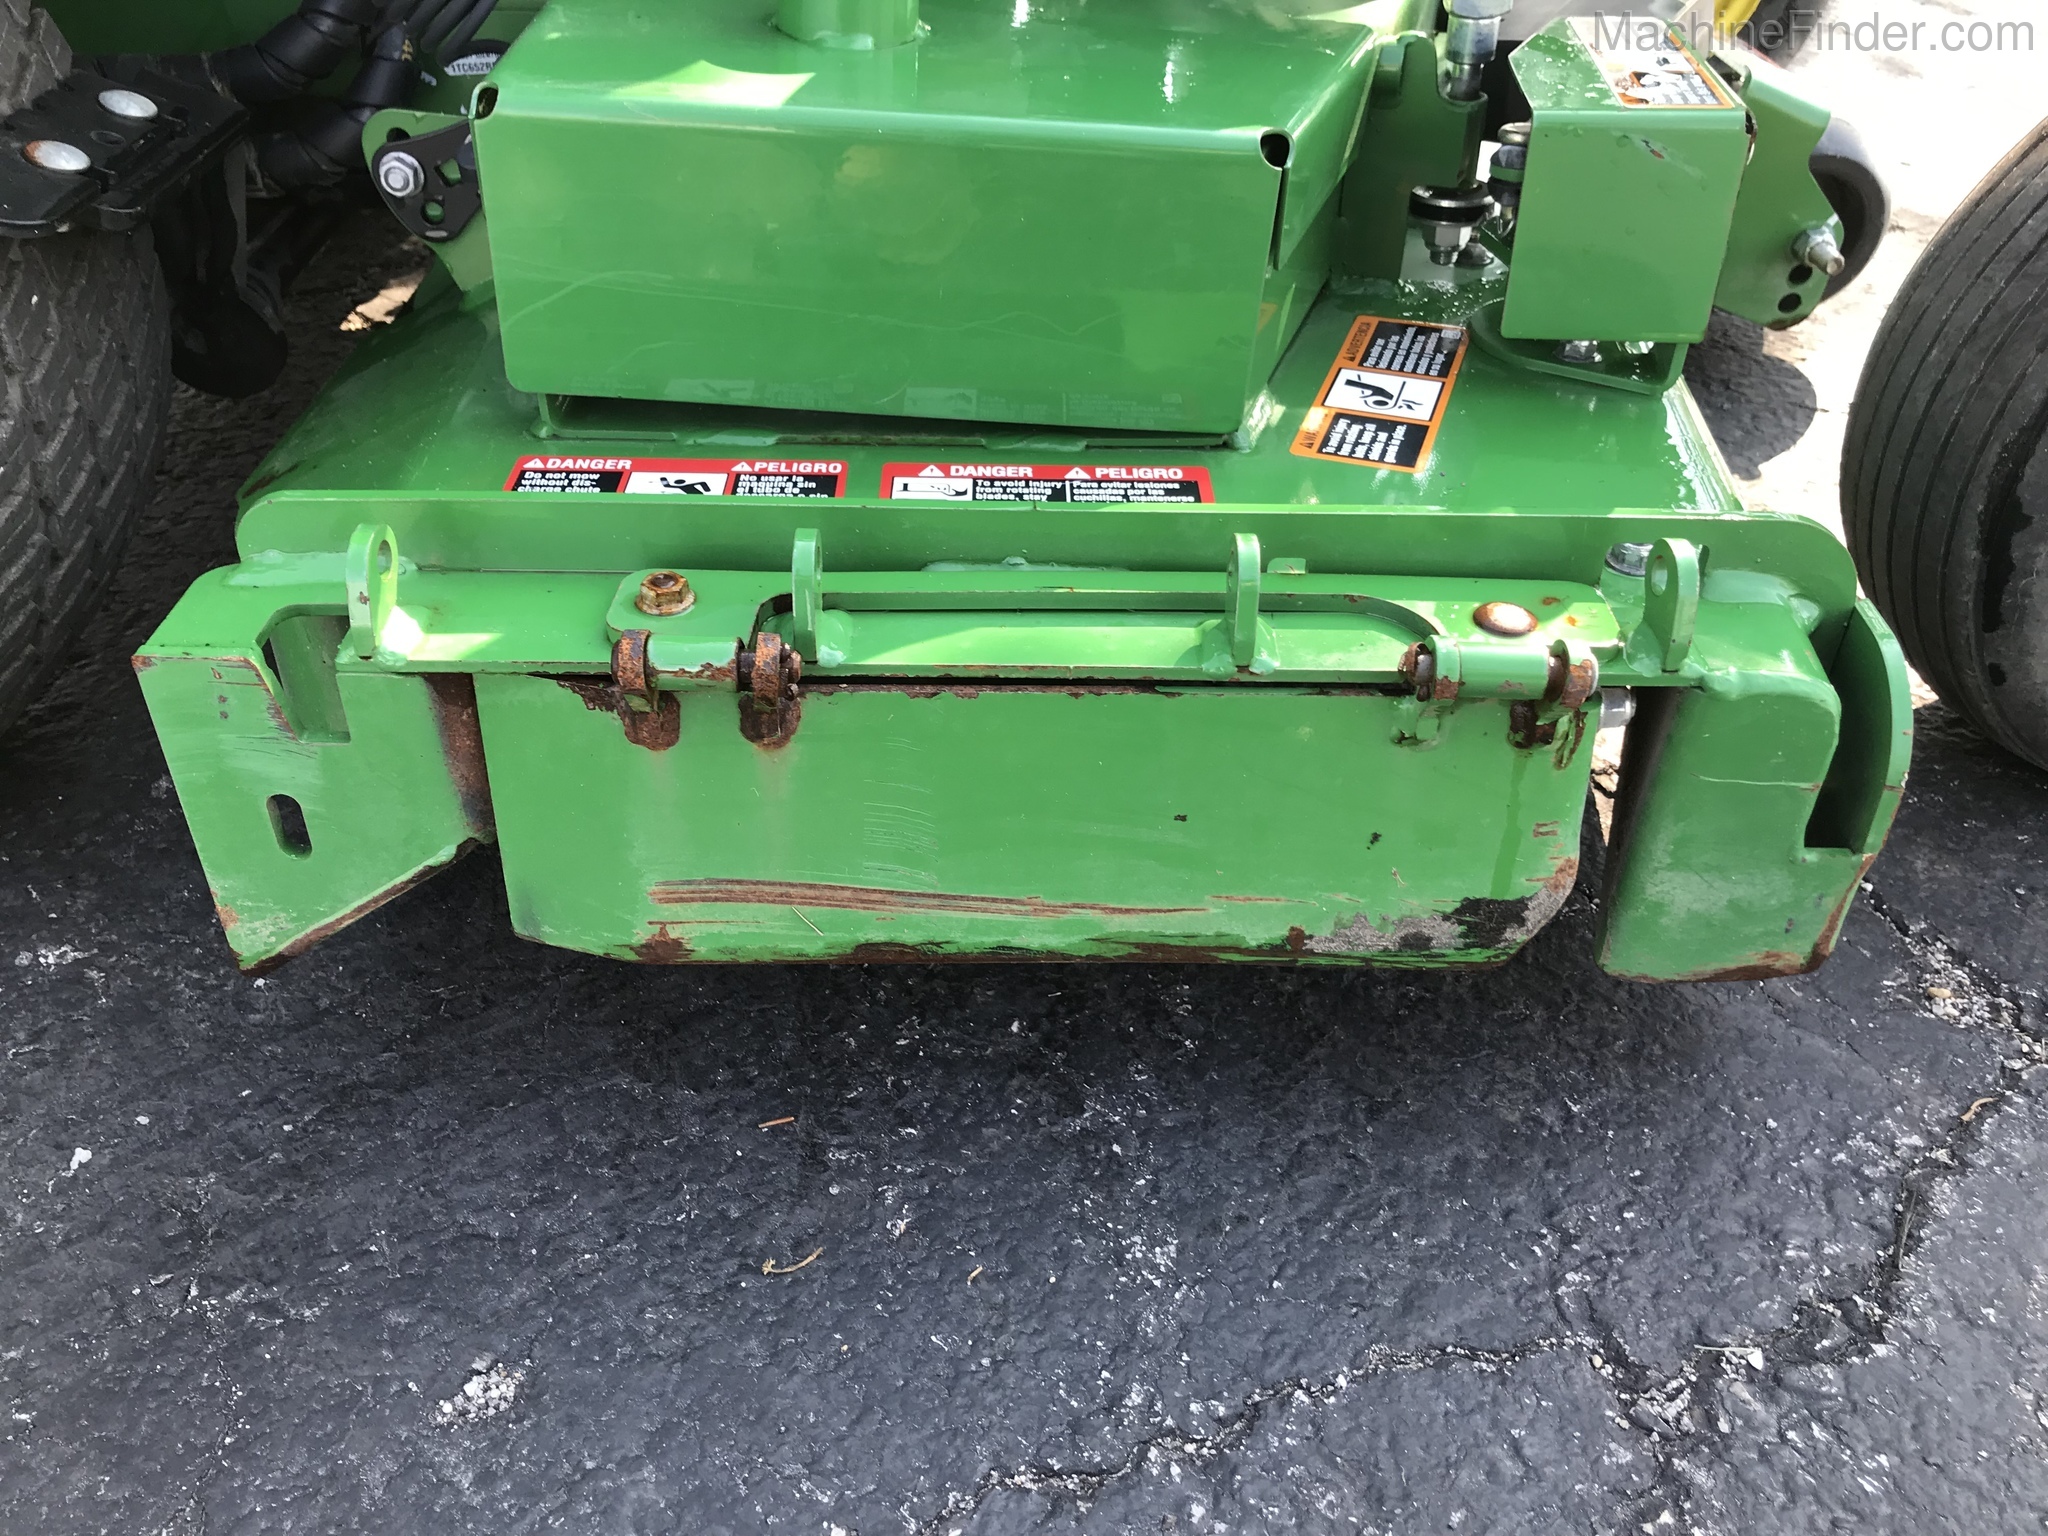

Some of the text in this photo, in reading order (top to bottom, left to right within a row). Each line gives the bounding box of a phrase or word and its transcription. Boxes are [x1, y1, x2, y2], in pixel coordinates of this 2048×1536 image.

[452, 62, 494, 72] 1TC652R
[546, 458, 632, 470] DANGER
[754, 462, 842, 473] PELIGRO
[950, 465, 1033, 477] DANGER
[1095, 468, 1183, 479] PELIGRO
[545, 472, 566, 480] not
[1029, 480, 1063, 489] injury
[1007, 487, 1052, 495] rotating
[975, 493, 1019, 501] blades,
[1073, 494, 1126, 502] cuchillas,
